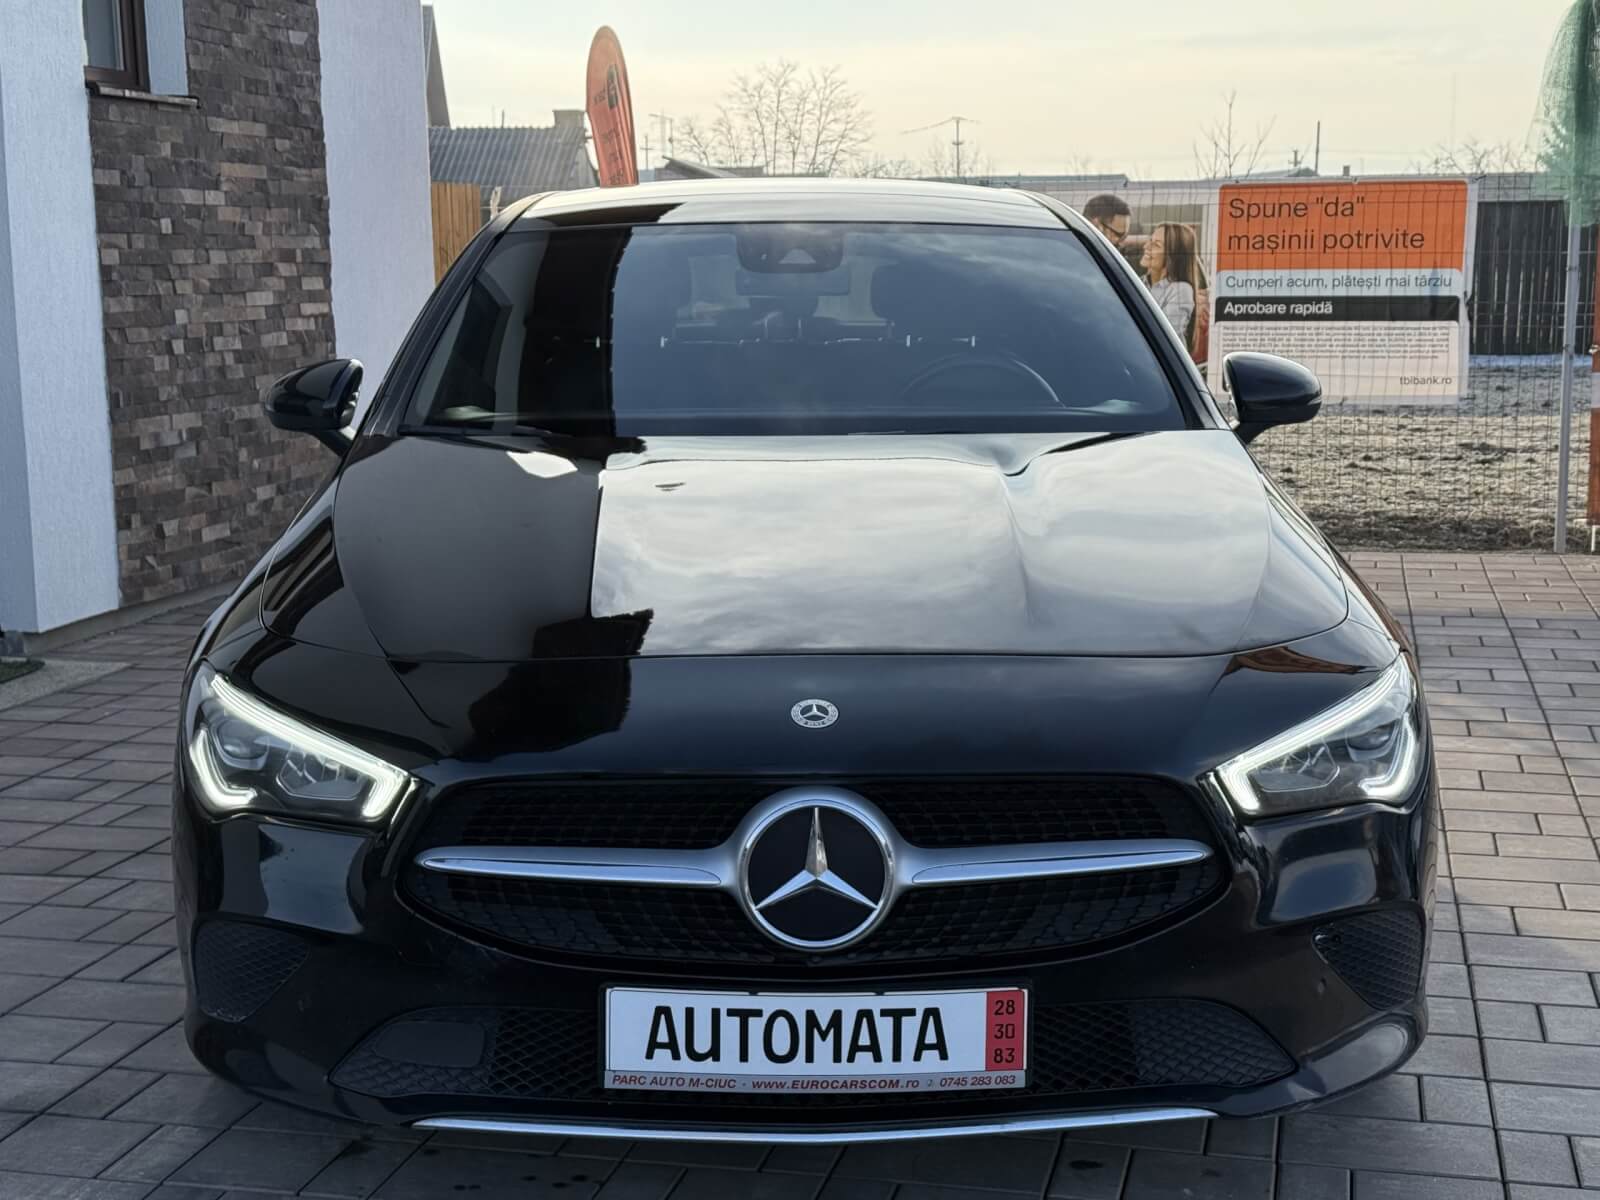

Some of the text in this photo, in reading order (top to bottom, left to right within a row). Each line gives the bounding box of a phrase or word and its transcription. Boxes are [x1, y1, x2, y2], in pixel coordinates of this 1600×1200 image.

[1229, 196, 1365, 223] Spune "da"
[1228, 228, 1425, 254] mașinii potrivite
[1225, 275, 1283, 290] Cumperi
[1286, 277, 1329, 289] acum,
[1385, 275, 1411, 287] mai
[1414, 274, 1453, 288] târziu
[1224, 301, 1333, 316] Aprobare rapidă
[1400, 375, 1453, 386] tbibank.ro
[993, 1000, 1016, 1016] 28
[644, 1005, 949, 1064] AUTOMATA
[993, 1024, 1016, 1040] 30
[993, 1048, 1016, 1064] 83
[612, 1074, 1016, 1090] PARC AUTO M-CIUC www.EUROCARSCOM.ro 0745 283 083
